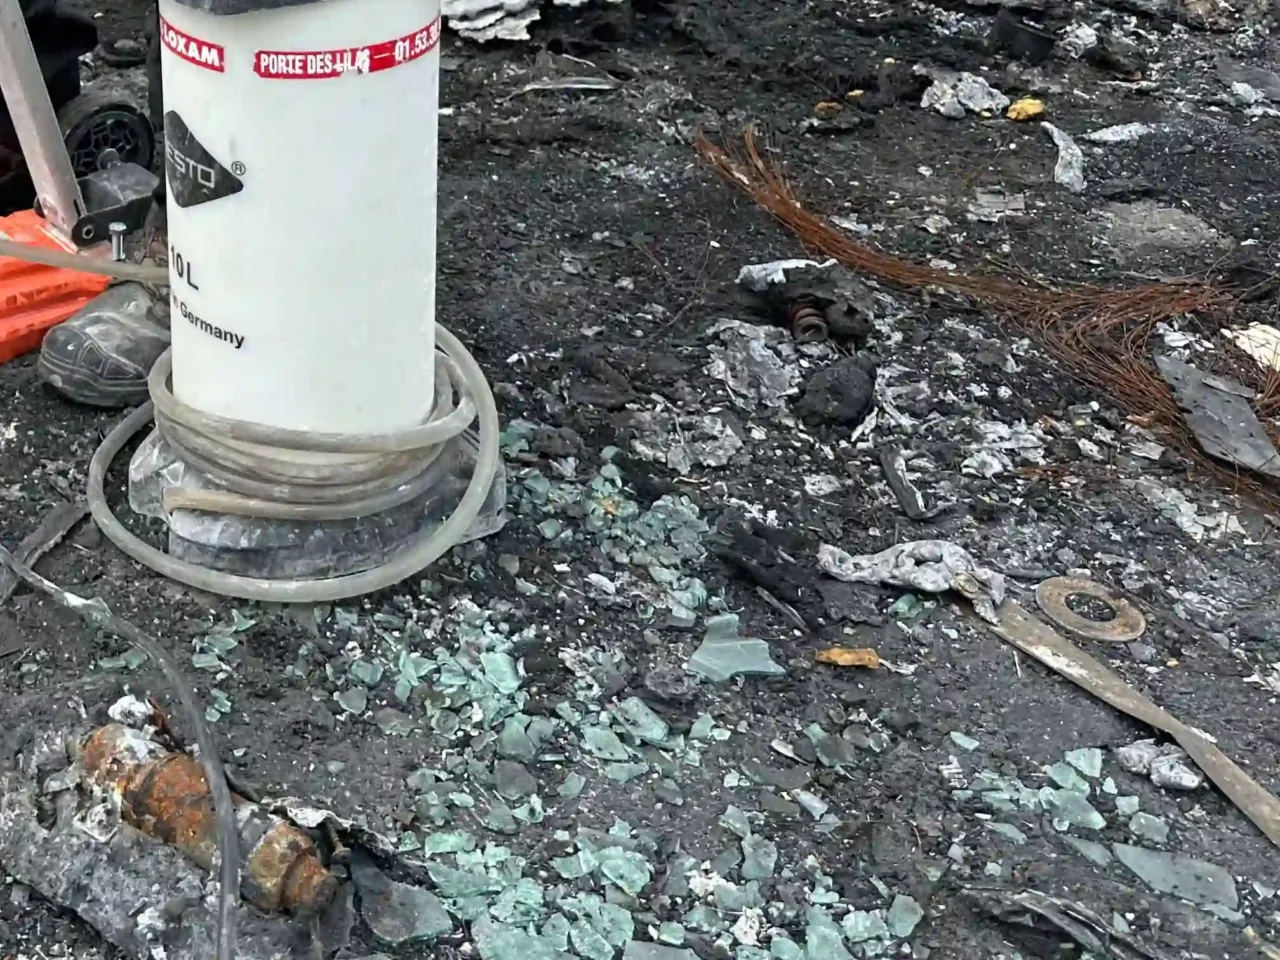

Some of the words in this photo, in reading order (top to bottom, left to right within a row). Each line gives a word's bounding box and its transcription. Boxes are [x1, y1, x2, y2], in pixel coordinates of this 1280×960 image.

[163, 23, 220, 67] LOXAM
[260, 53, 304, 74] PORTE
[307, 54, 332, 75] DES
[186, 261, 199, 291] L
[180, 301, 245, 349] Germany
